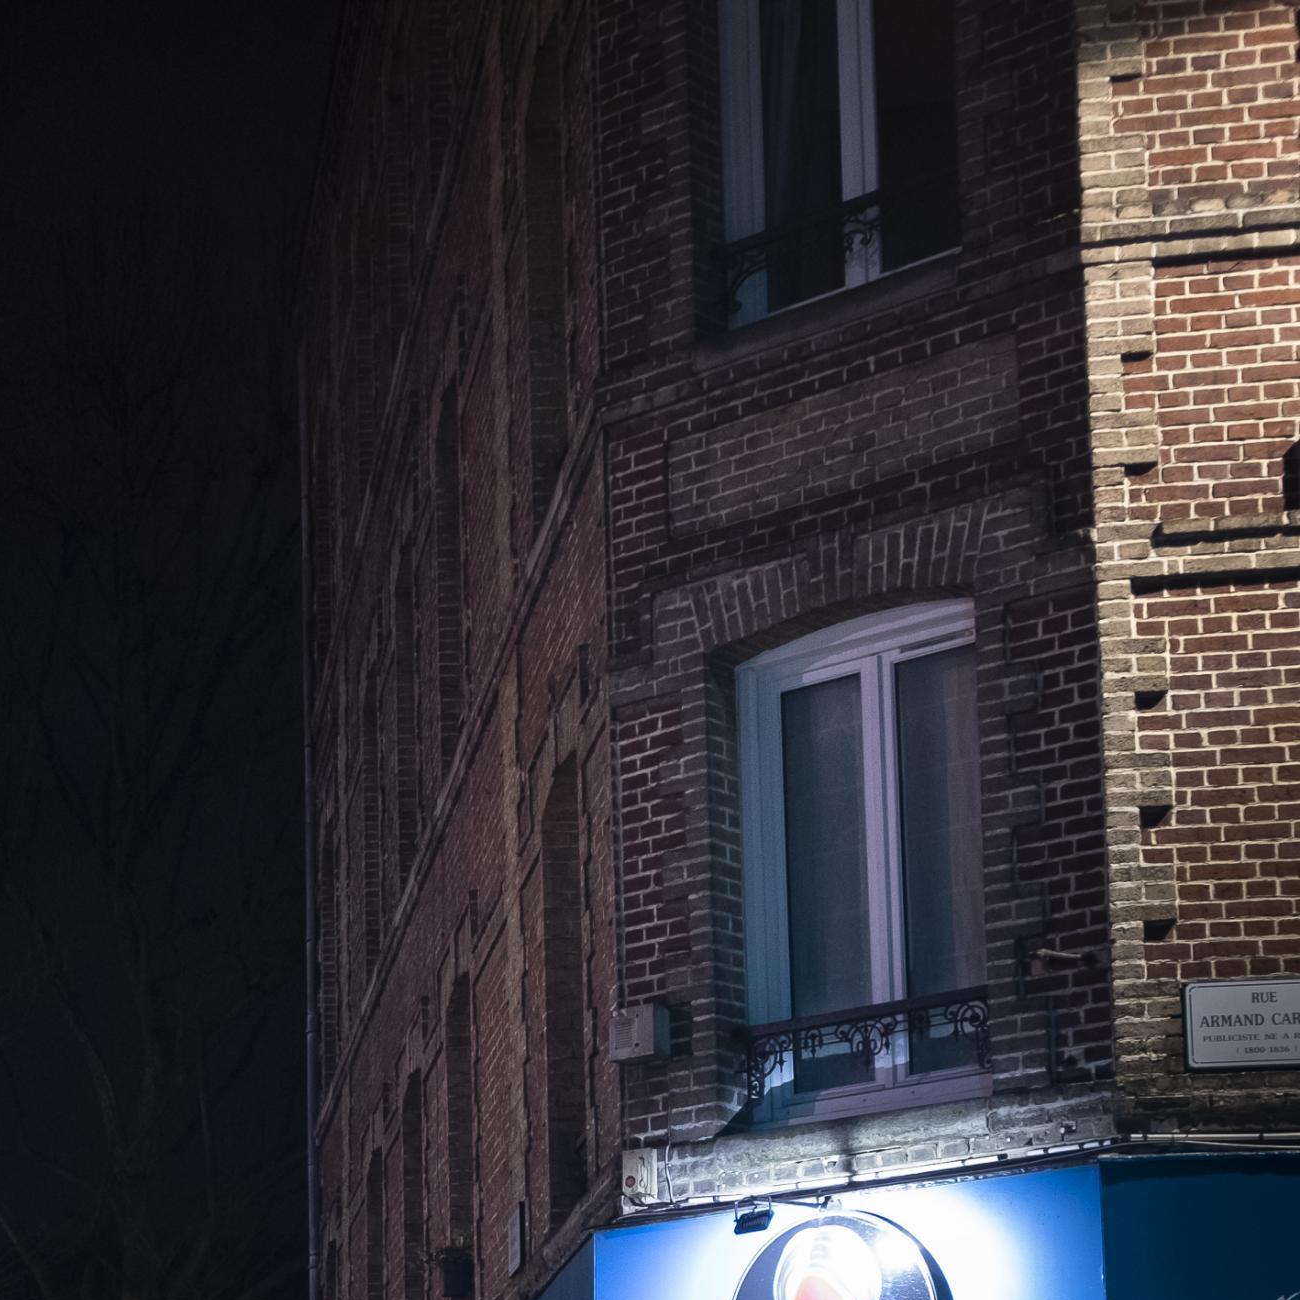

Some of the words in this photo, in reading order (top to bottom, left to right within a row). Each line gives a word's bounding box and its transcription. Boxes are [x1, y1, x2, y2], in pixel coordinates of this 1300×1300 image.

[1251, 991, 1278, 1003] RUE
[1199, 1013, 1265, 1028] ARMAND
[1202, 1033, 1260, 1043] PUBLICISTE
